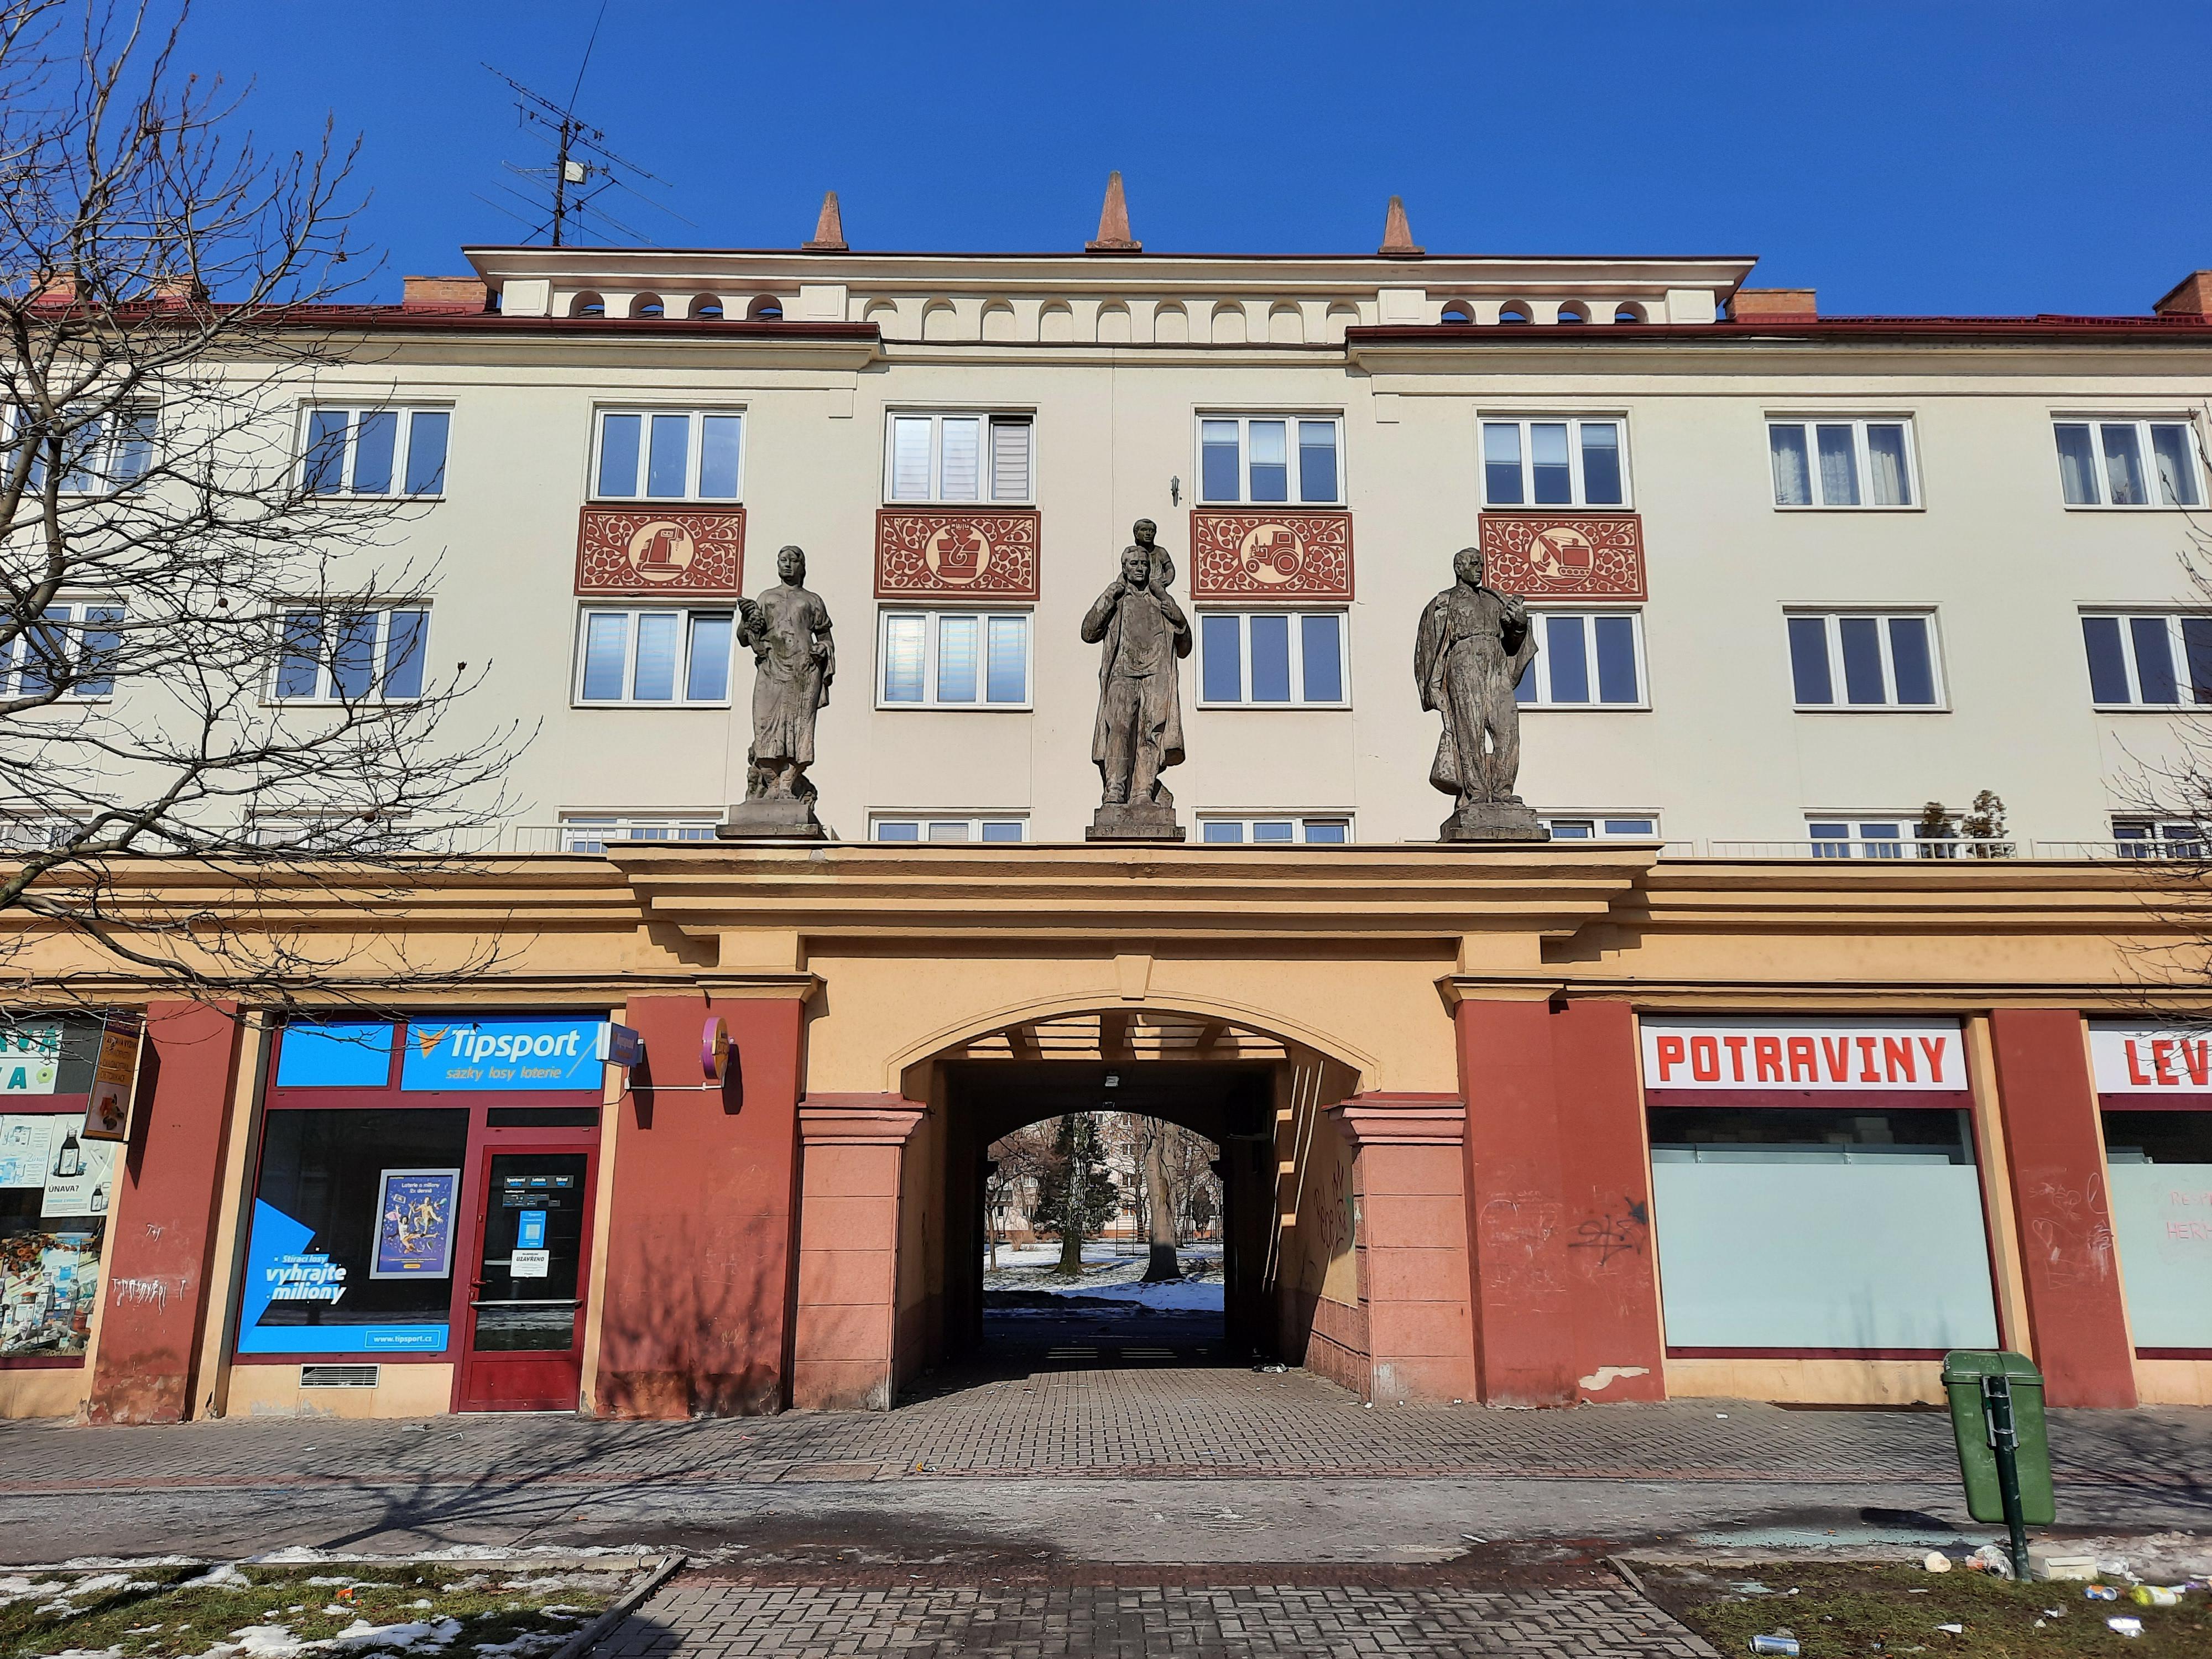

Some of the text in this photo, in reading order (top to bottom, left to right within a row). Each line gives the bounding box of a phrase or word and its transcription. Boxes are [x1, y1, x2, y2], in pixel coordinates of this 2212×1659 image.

[451, 1029, 580, 1063] Tipsport
[1656, 1036, 1947, 1083] POTRAVINY
[2125, 1040, 2208, 1085] LEV
[445, 1066, 562, 1081] sázky losy loterie
[309, 1255, 327, 1264] losy
[266, 1263, 347, 1286] vyhrajte
[272, 1282, 347, 1305] miliony
[373, 1335, 432, 1344] www.tipsport.cz
